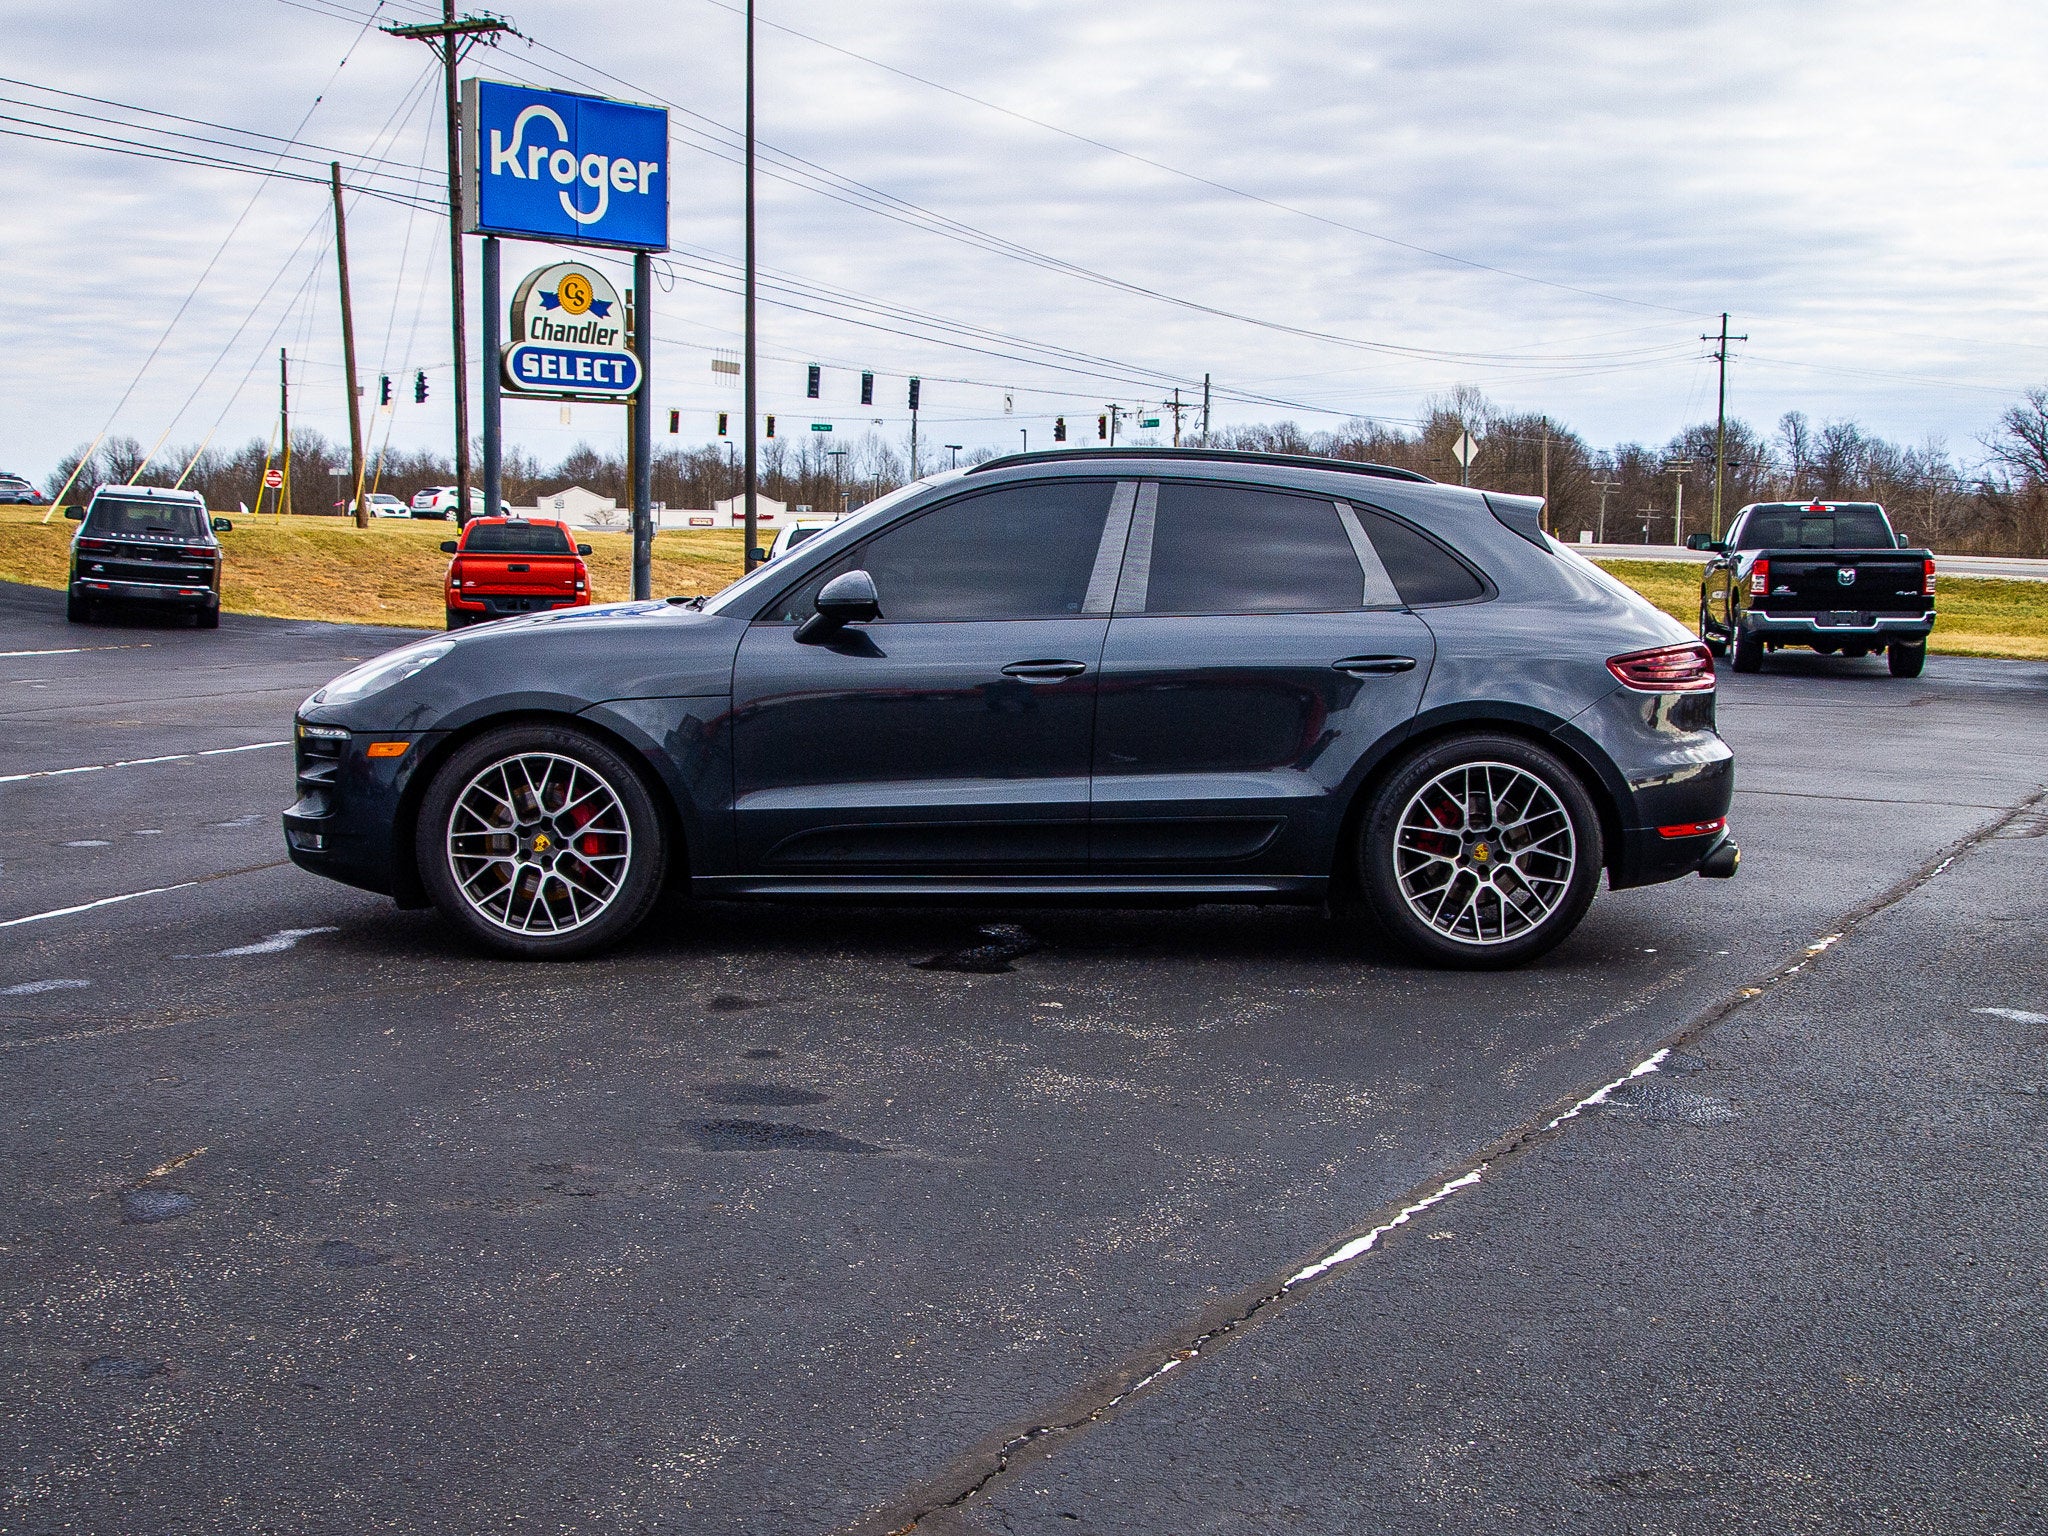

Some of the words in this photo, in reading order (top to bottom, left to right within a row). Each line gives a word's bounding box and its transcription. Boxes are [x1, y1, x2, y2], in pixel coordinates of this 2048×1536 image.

[490, 104, 659, 225] Kroger
[530, 316, 619, 346] Chandler
[522, 353, 627, 384] SELECT
